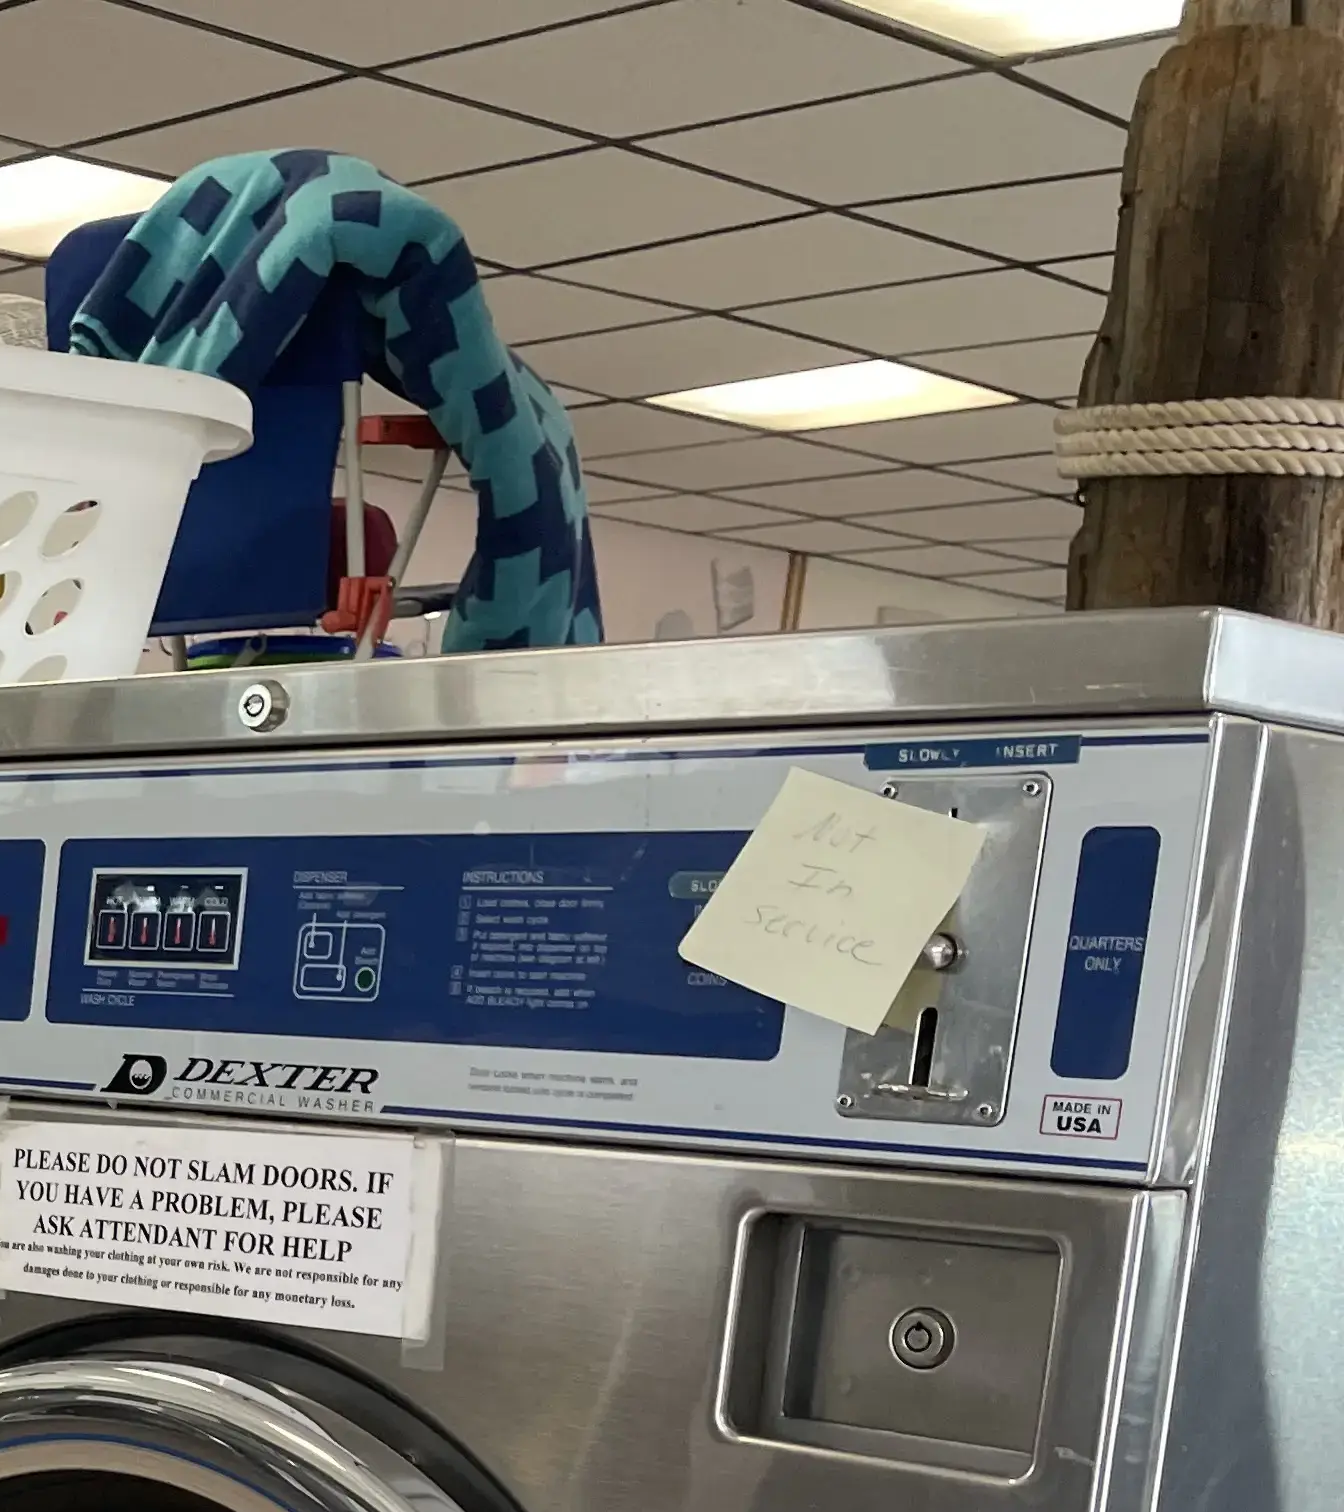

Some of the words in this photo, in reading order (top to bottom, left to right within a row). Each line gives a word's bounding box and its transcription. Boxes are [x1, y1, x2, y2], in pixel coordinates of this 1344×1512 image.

[995, 742, 1059, 759] INSERT
[462, 870, 544, 884] INSTRUCTIONS
[787, 863, 853, 896] In
[1068, 935, 1145, 952] QUARTERS
[1084, 956, 1123, 974] ONLY
[173, 1057, 379, 1094] DEXTER
[171, 1086, 286, 1107] COMMERCIAL
[297, 1096, 375, 1113] WASHER
[1052, 1101, 1092, 1114] MADE
[1096, 1103, 1112, 1115] IN
[1056, 1116, 1102, 1134] USA
[13, 1147, 91, 1174] PLEASE
[95, 1153, 128, 1176] DO
[133, 1156, 183, 1180] NOT
[187, 1159, 256, 1186] SLAM
[261, 1163, 358, 1193] DOORS.
[365, 1170, 395, 1195] IF
[16, 1179, 60, 1202] YOU
[64, 1183, 124, 1209] HAVE
[128, 1189, 145, 1210] A
[151, 1189, 276, 1225] PROBLEM,
[281, 1200, 383, 1230] PLEASE
[33, 1213, 76, 1237] ASK
[79, 1217, 218, 1250] ATTENDANT
[222, 1229, 276, 1257] FOR
[281, 1235, 353, 1263] HELP
[11, 1242, 26, 1251] are
[27, 1241, 45, 1253] also
[46, 1244, 82, 1260] washing
[83, 1250, 106, 1261] your
[107, 1250, 145, 1266] clothing
[146, 1254, 157, 1266] at
[158, 1257, 182, 1269] your
[183, 1261, 205, 1270] own
[207, 1260, 231, 1273] risk.
[233, 1261, 252, 1275] We
[254, 1267, 272, 1277] are
[275, 1268, 293, 1279] not
[295, 1271, 360, 1286] responsible
[362, 1274, 379, 1288] for
[382, 1279, 403, 1293] any
[23, 1261, 60, 1278] damages
[62, 1266, 83, 1280] done
[86, 1269, 95, 1280] to
[96, 1272, 118, 1284] your
[120, 1273, 158, 1290] clothing
[160, 1279, 172, 1289] or
[174, 1280, 231, 1297] responsible
[233, 1285, 250, 1298] for
[252, 1290, 272, 1301] any
[274, 1291, 328, 1309] monetary
[330, 1294, 356, 1309] loss.
